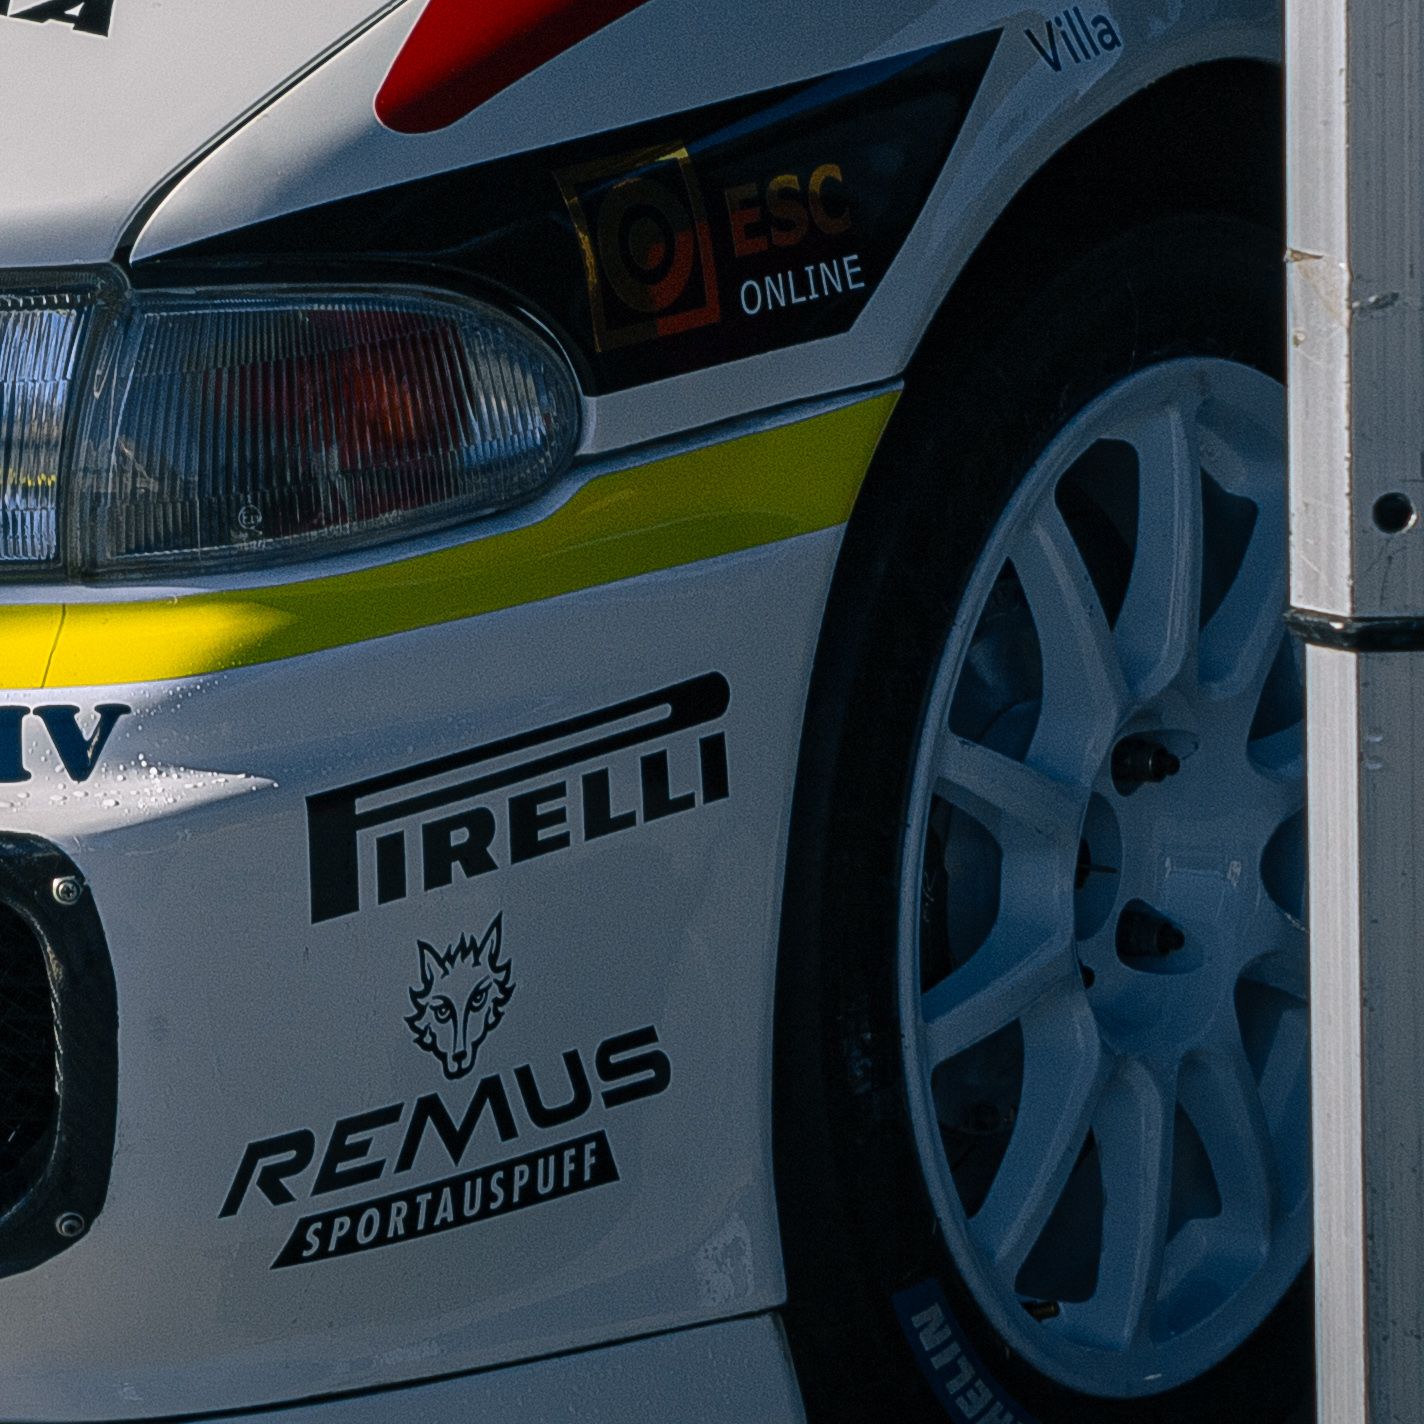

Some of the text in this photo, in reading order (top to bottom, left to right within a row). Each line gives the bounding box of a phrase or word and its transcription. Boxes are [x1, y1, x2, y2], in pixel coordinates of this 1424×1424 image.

[1023, 6, 1123, 73] Villa
[725, 162, 853, 258] ESC
[740, 254, 866, 316] ONLINE
[305, 669, 731, 926] PIRELLI
[217, 1024, 672, 1219] REMUS
[301, 1142, 602, 1258] SPORTAUSPUFF
